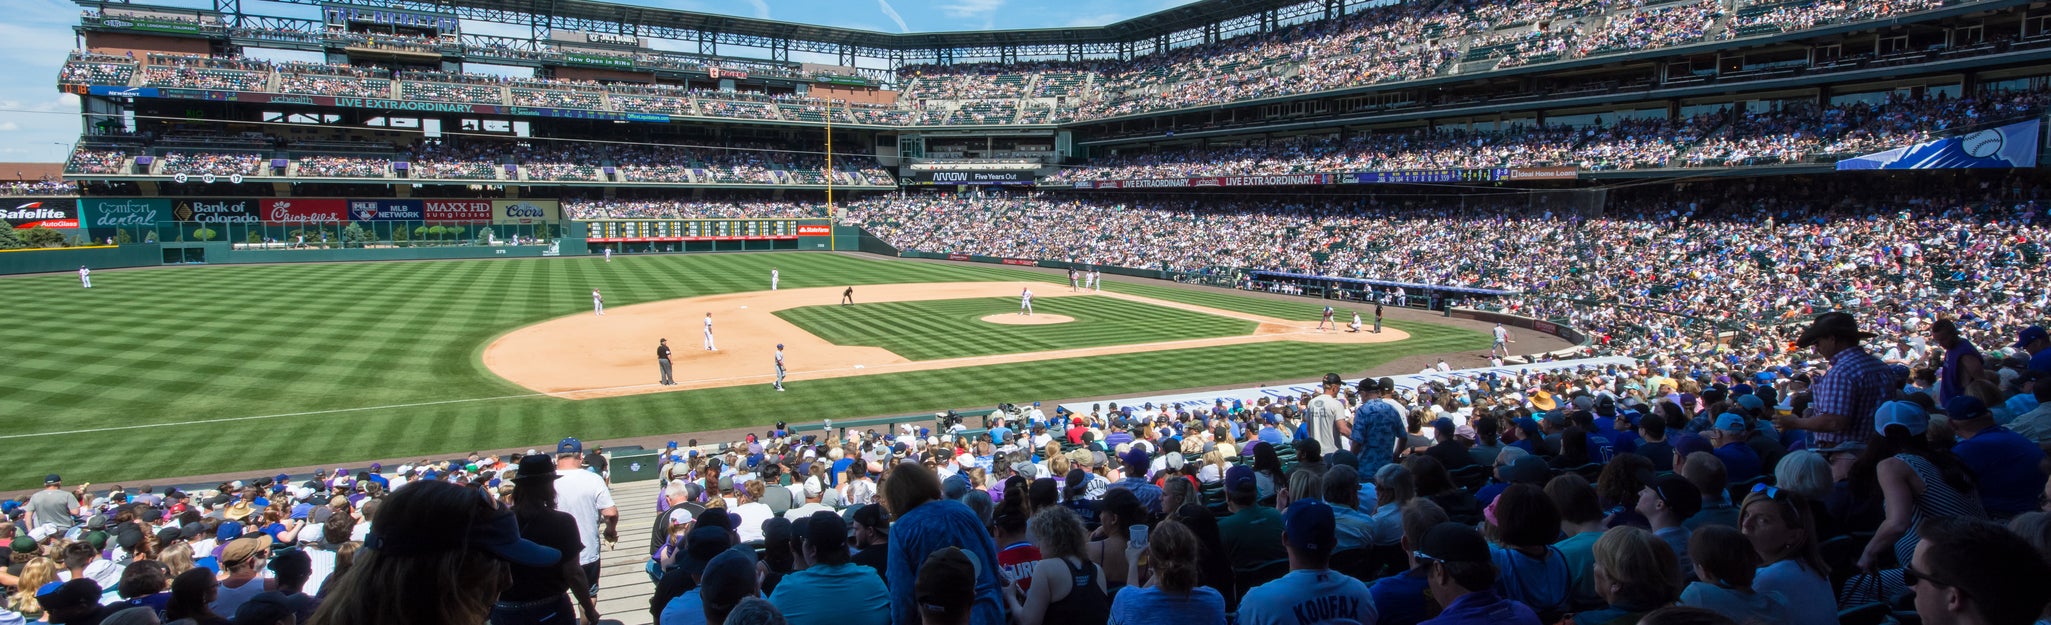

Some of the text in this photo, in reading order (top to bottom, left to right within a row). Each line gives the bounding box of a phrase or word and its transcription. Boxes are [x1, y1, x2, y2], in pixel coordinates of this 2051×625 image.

[324, 6, 458, 30] THE ROOFTOP
[270, 94, 475, 113] uchealth LIVE EXTRAORDINARY.
[175, 175, 187, 183] 42
[232, 175, 241, 183] 17
[933, 172, 968, 181] ARROW
[1123, 180, 1135, 188] LIVE
[1136, 178, 1190, 188] EXTRAORDINARY.
[1226, 177, 1242, 186] LIVE
[1243, 175, 1317, 186] EXTRAORDINARY.
[99, 202, 150, 214] Comfort
[194, 201, 246, 213] Bank of
[427, 202, 490, 212] MAXX HD
[506, 204, 544, 218] Coors
[0, 208, 65, 219] Safelite
[97, 210, 157, 226] dental
[194, 213, 259, 224] Colorado
[1292, 595, 1361, 625] KOUFAX
